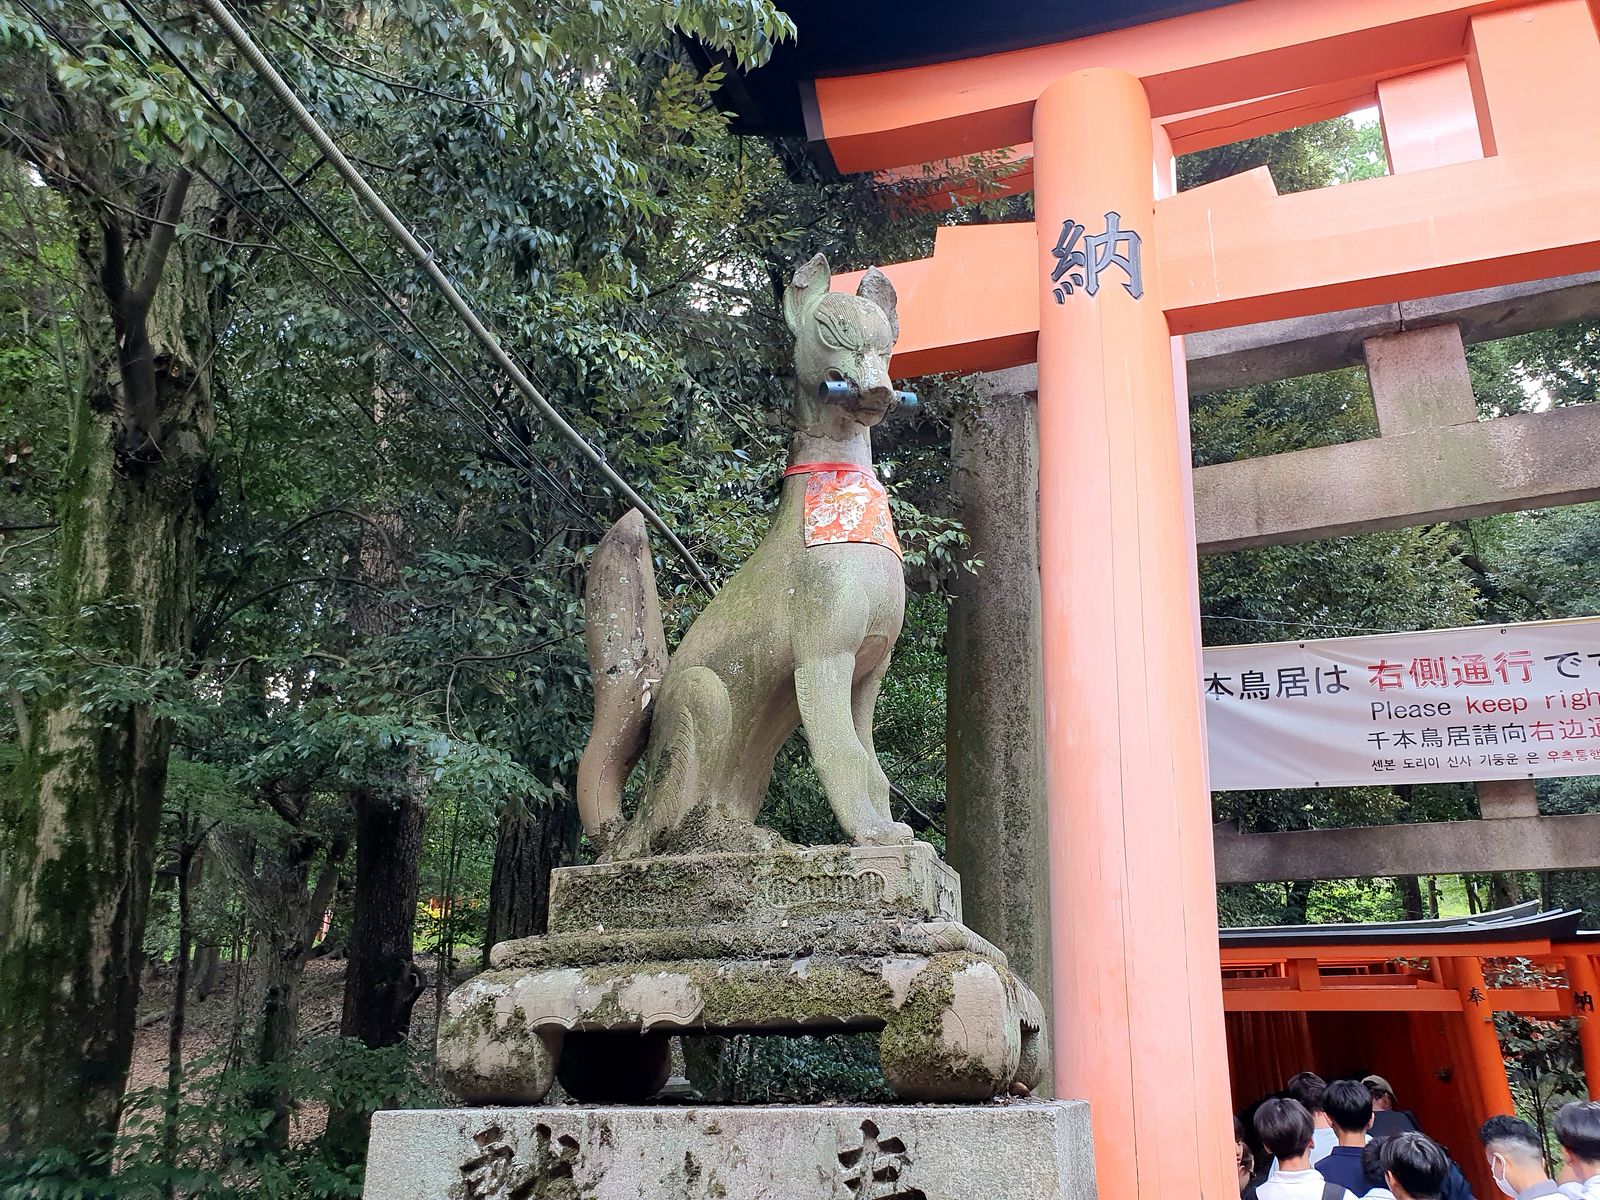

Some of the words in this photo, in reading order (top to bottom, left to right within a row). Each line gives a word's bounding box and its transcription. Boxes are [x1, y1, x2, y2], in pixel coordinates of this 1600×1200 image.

[1051, 211, 1144, 304] 納
[1367, 650, 1535, 691] 右側通行
[1371, 701, 1451, 721] Please
[1466, 696, 1528, 714] keep
[1371, 758, 1396, 772] 센본
[1402, 757, 1440, 770] 도리이
[1446, 755, 1473, 768] 신사
[1526, 751, 1540, 765] 은
[1468, 987, 1486, 1007] 奉
[1574, 991, 1594, 1012] 納
